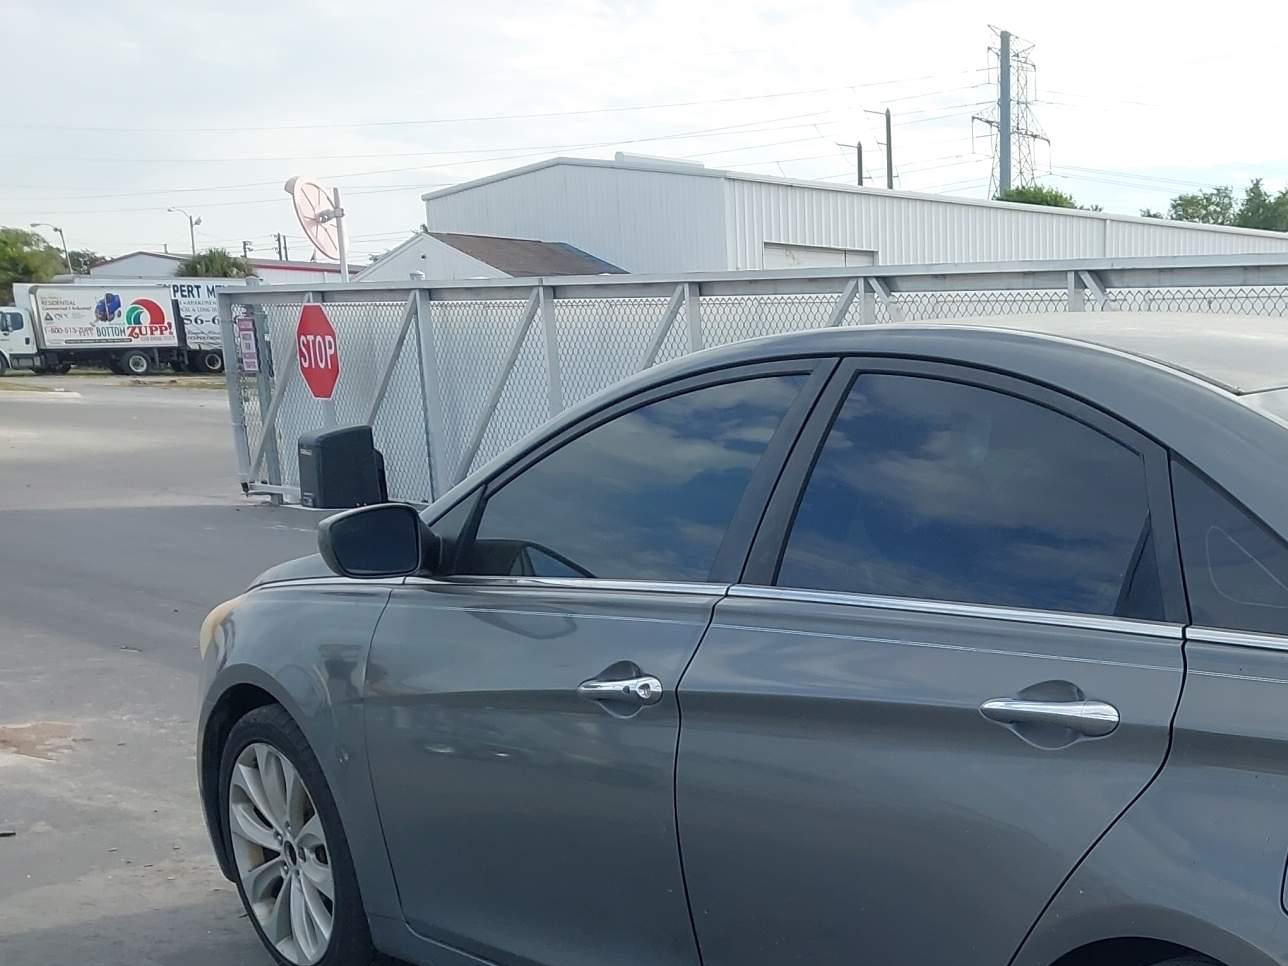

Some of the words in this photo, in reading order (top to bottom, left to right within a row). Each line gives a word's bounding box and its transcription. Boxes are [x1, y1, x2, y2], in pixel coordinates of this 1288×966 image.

[96, 326, 126, 337] BOTTOM
[127, 321, 174, 339] ZUPP!
[300, 335, 335, 369] STOP
